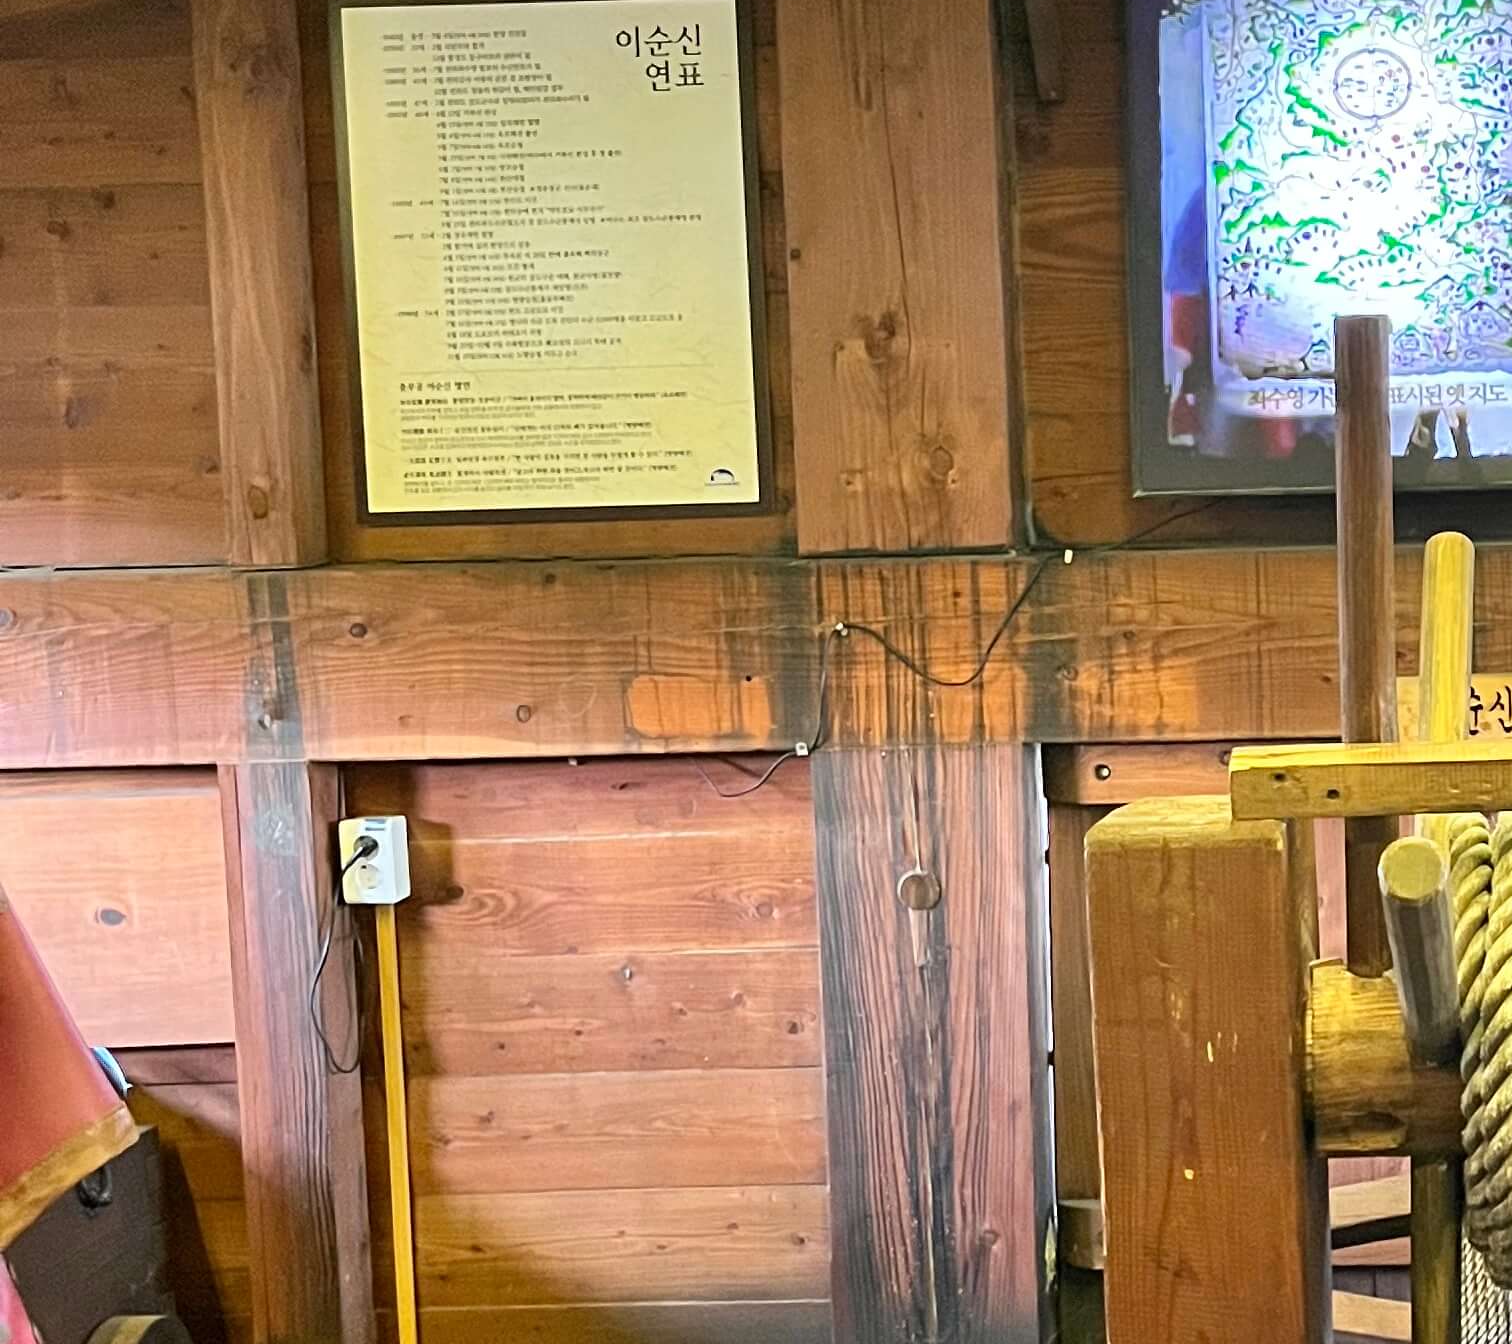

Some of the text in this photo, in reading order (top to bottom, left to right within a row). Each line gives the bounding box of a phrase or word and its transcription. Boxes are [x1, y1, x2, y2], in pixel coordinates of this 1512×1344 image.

[616, 23, 702, 57] 이순신
[646, 60, 704, 92] 연표
[1469, 383, 1508, 404] 지도
